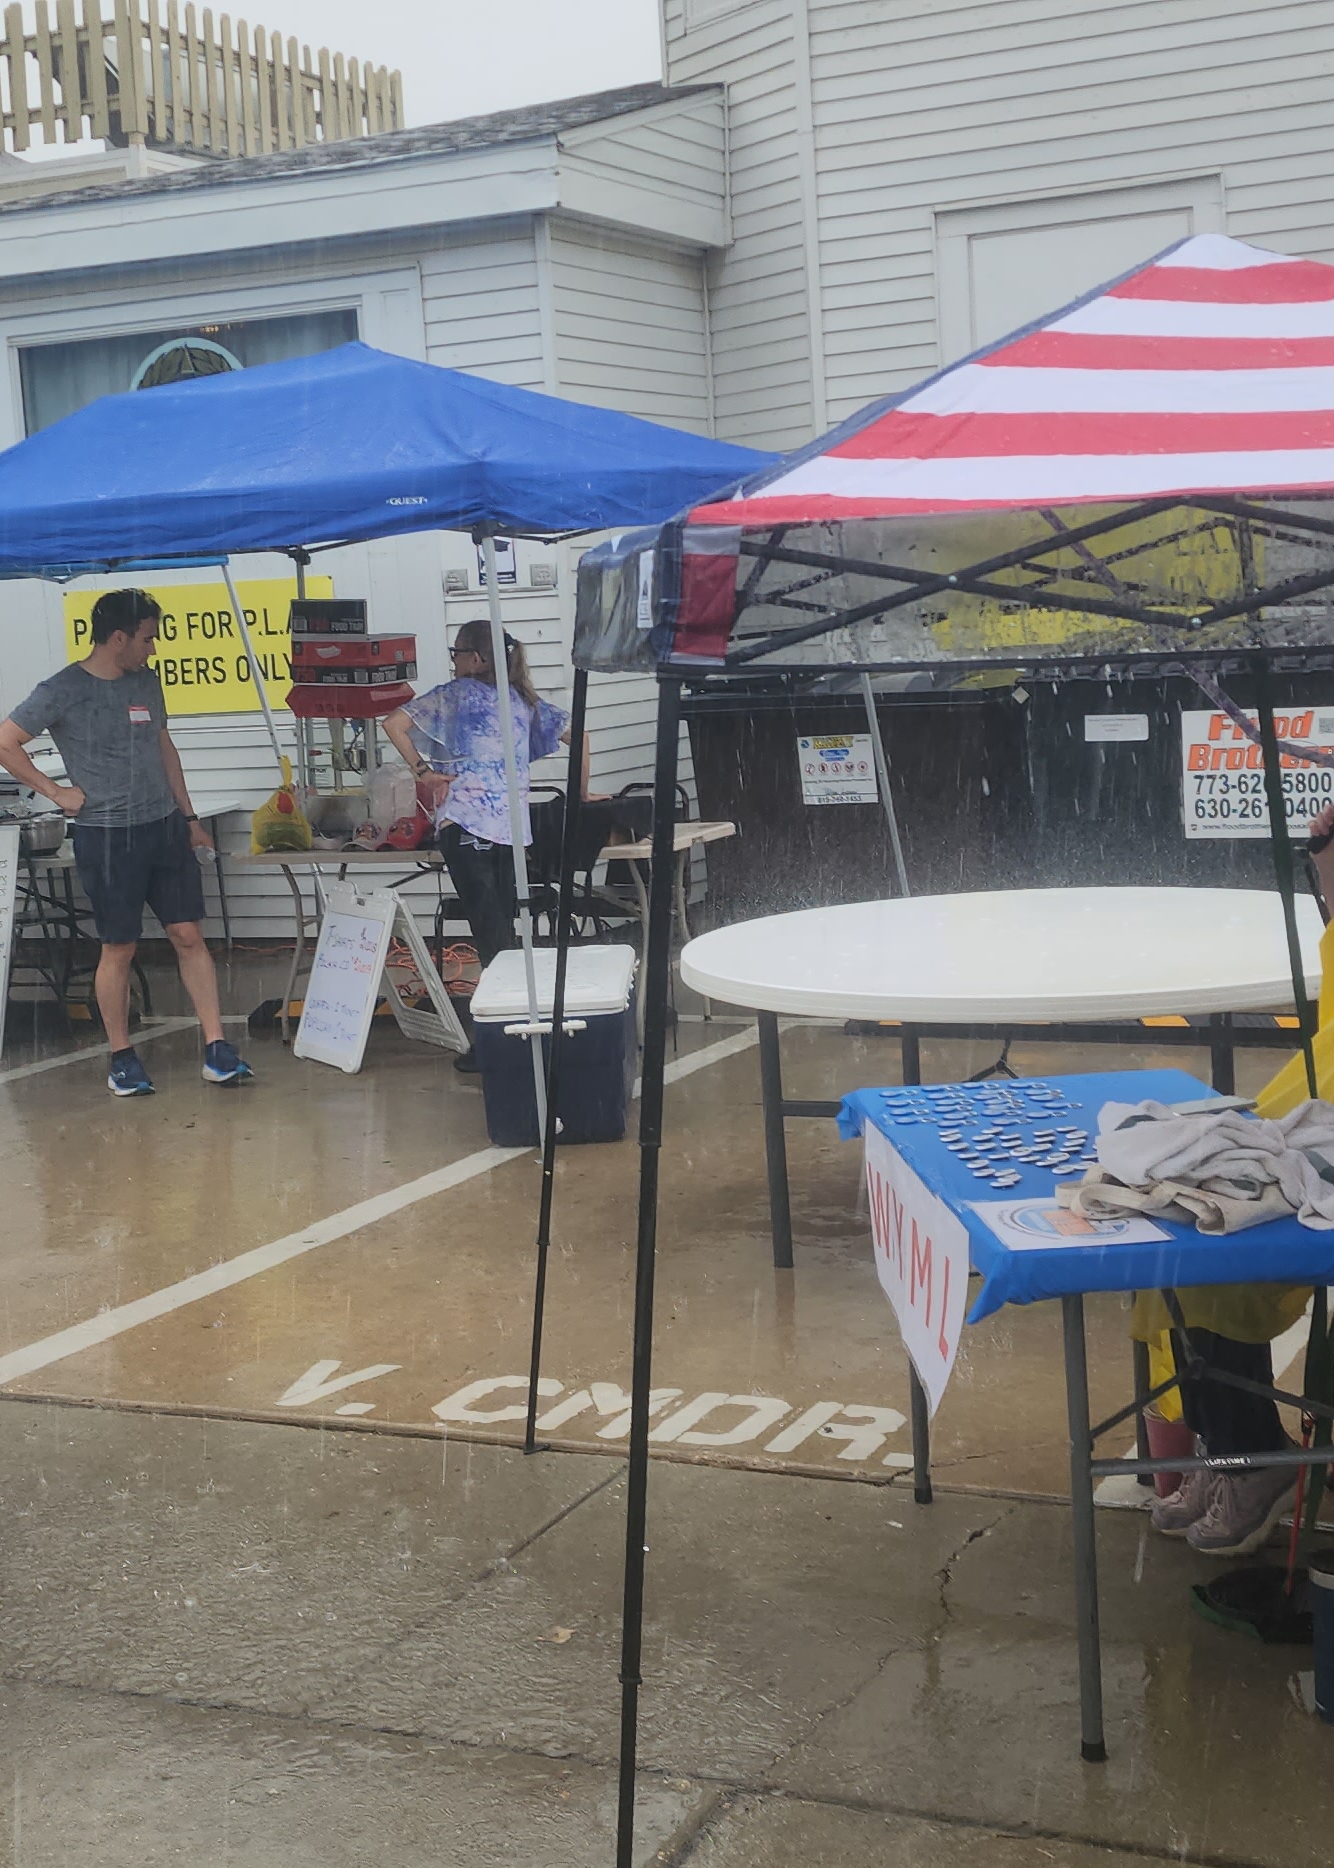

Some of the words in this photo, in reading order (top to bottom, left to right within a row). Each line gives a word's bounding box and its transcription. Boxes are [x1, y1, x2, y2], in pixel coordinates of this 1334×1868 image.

[389, 496, 425, 506] QUEST
[186, 609, 235, 640] FOR
[154, 655, 227, 687] BERS
[868, 1161, 950, 1363] WYML
[274, 1359, 403, 1416] V.
[430, 1374, 915, 1468] CMDR.
